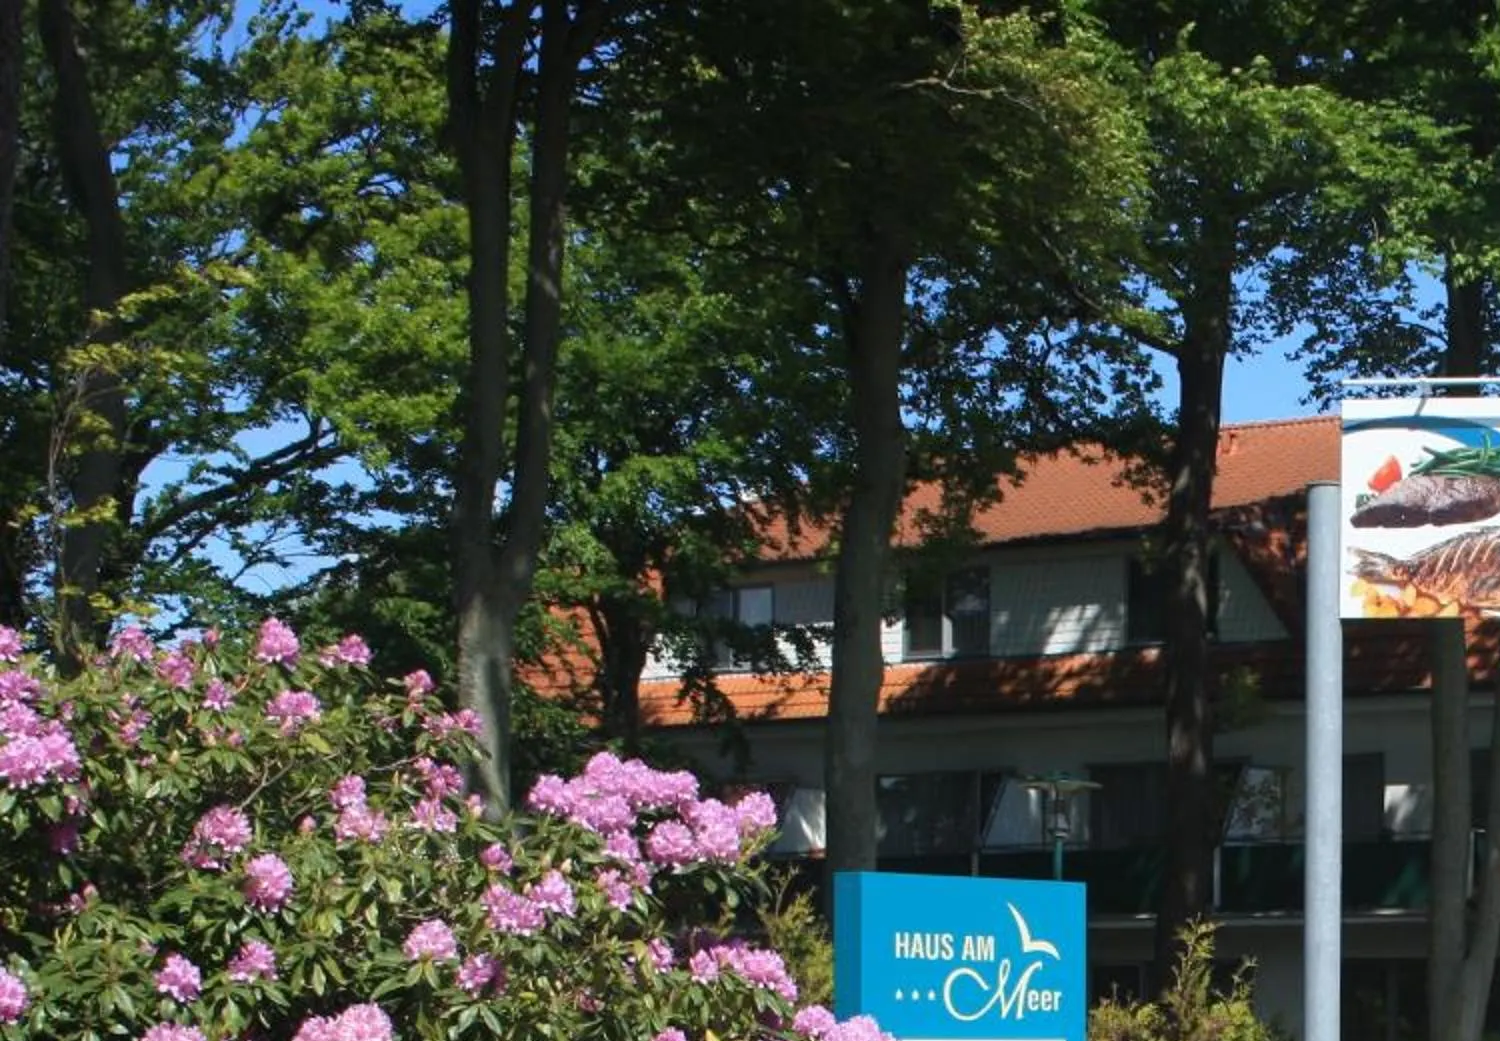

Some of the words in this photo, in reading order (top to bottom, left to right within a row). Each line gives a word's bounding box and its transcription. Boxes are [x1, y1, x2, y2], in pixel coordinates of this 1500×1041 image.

[895, 932, 955, 961] HAUS
[962, 935, 995, 962] AM
[943, 959, 1062, 1021] Meer
